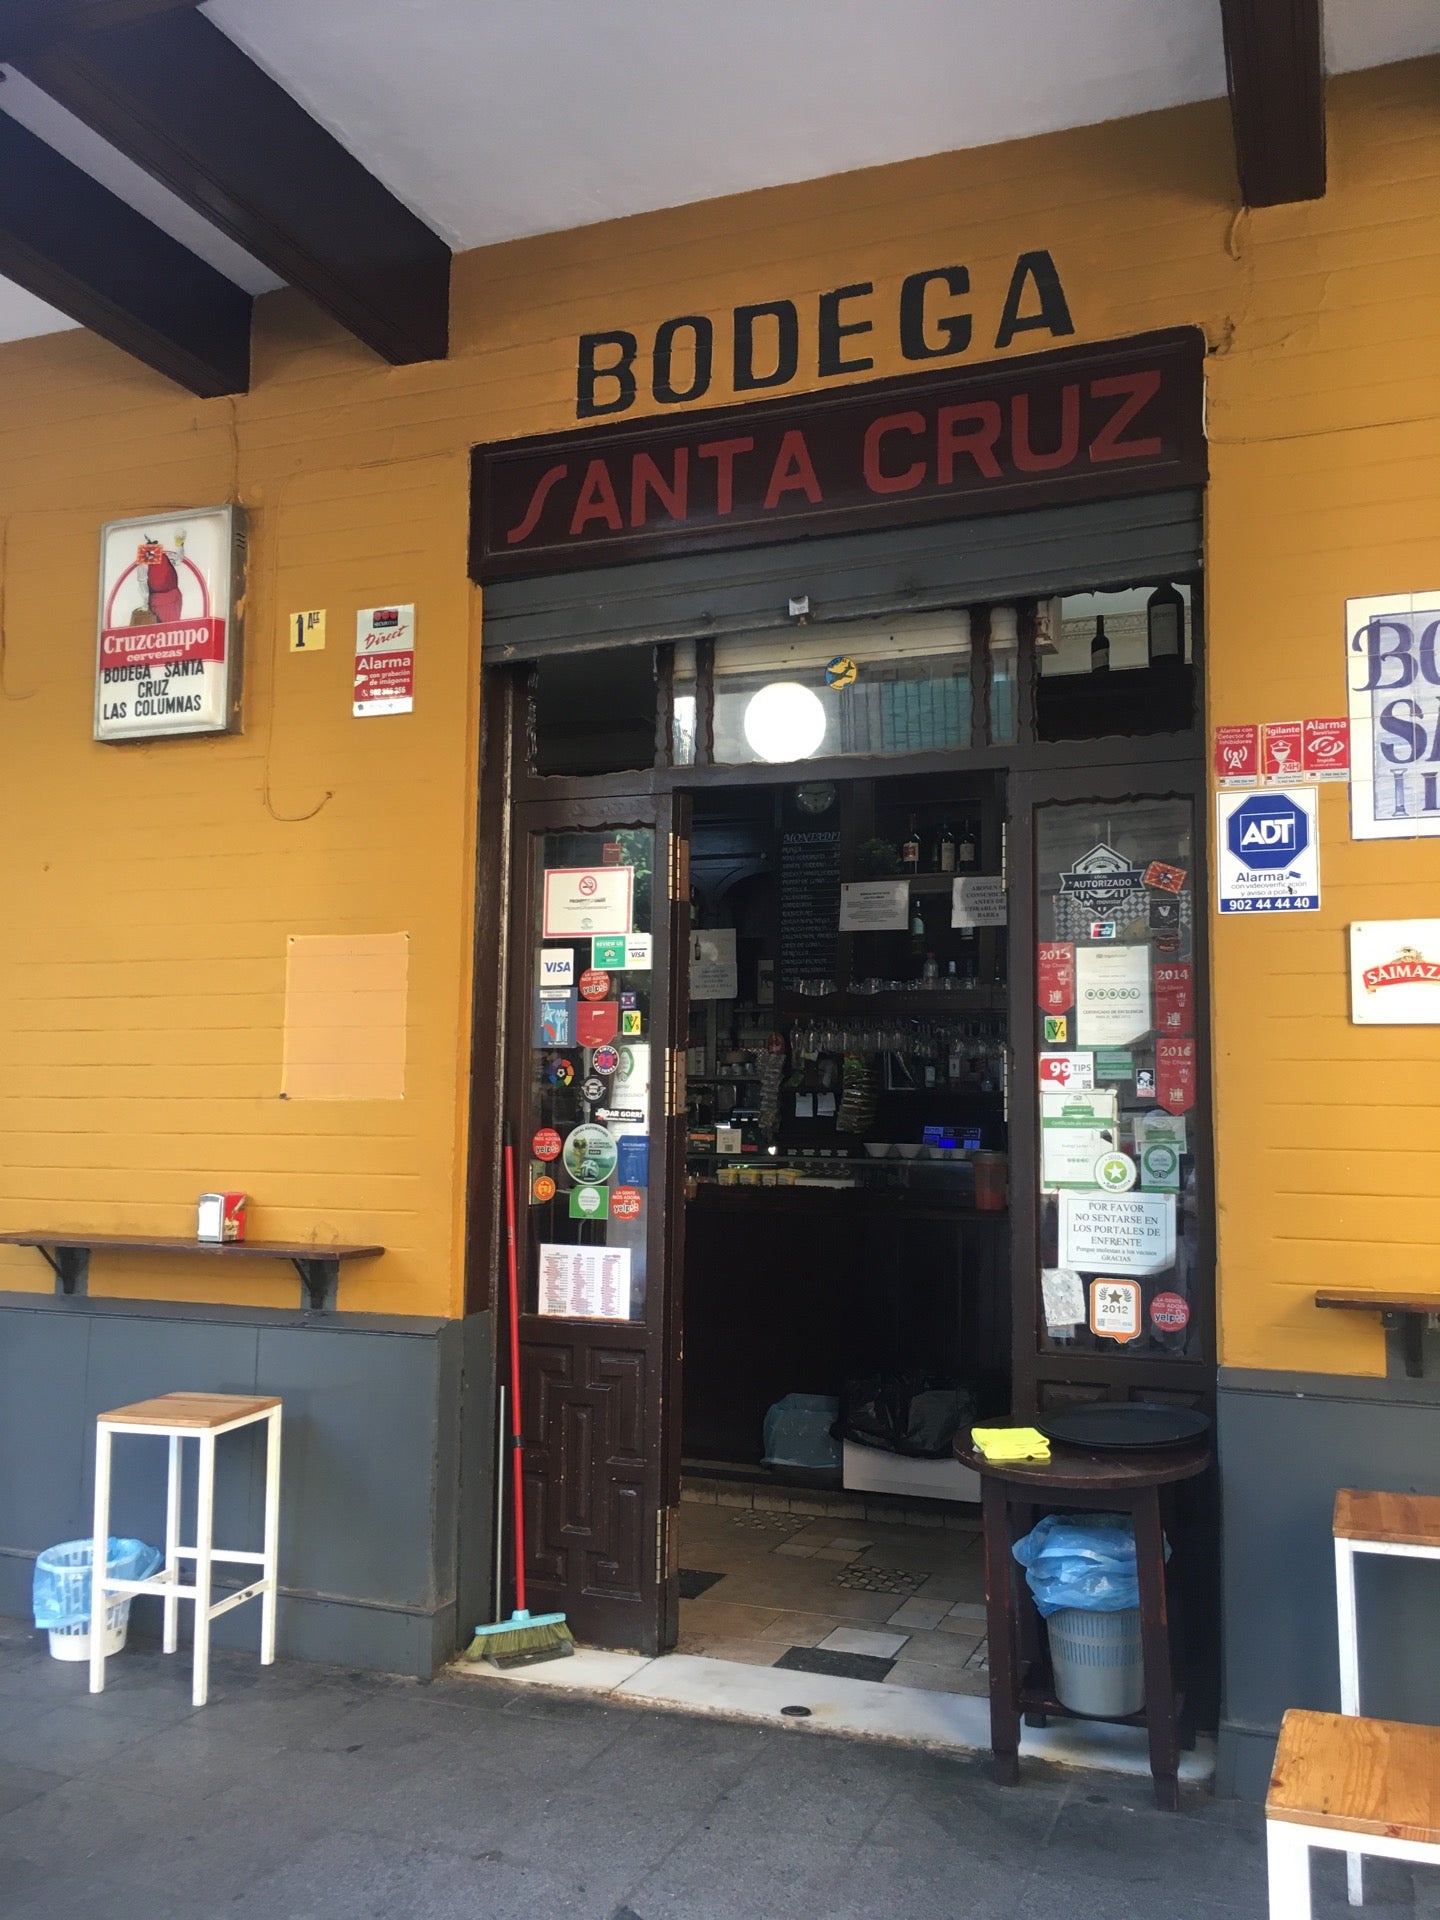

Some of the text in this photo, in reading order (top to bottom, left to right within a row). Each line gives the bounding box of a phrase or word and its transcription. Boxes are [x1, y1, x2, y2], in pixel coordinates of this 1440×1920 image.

[576, 250, 1075, 418] BODEGA
[507, 370, 1162, 544] SANTA CRUZ
[296, 614, 306, 648] 1
[364, 624, 409, 650] Direct
[104, 627, 210, 654] Cruzcampo
[127, 649, 184, 662] cervezas
[357, 656, 411, 671] Alarma
[104, 658, 205, 684] BODEGA SANTA
[381, 669, 410, 679] grabación
[138, 679, 170, 698] CRUZ
[104, 695, 202, 720] LAS COLUMNAS
[1306, 720, 1347, 731] Alarma
[1380, 697, 1440, 764] S
[1282, 762, 1300, 772] 24H
[1241, 818, 1295, 846] ADT
[1073, 879, 1132, 888] AUTORIZADO
[1236, 872, 1285, 884] Alarma
[1247, 888, 1265, 896] aviso
[1229, 897, 1310, 911] 902 44 44 40
[1039, 949, 1071, 961] 2015
[544, 962, 571, 973] VISA
[1158, 969, 1189, 980] 2014
[1366, 964, 1440, 985] SAIMAZ
[584, 986, 599, 995] yelp
[1049, 1062, 1092, 1076] 99 TIPS
[536, 1145, 551, 1154] yelp
[614, 1204, 629, 1213] yelp
[1088, 1202, 1145, 1213] POR FAVOR
[1075, 1213, 1159, 1225] NO SENTARSE EN
[1073, 1223, 1161, 1237] LOS PORTALES DE
[1091, 1236, 1142, 1247] ENFRENTE
[1101, 1304, 1128, 1314] 2012
[1155, 1312, 1175, 1324] yelp
